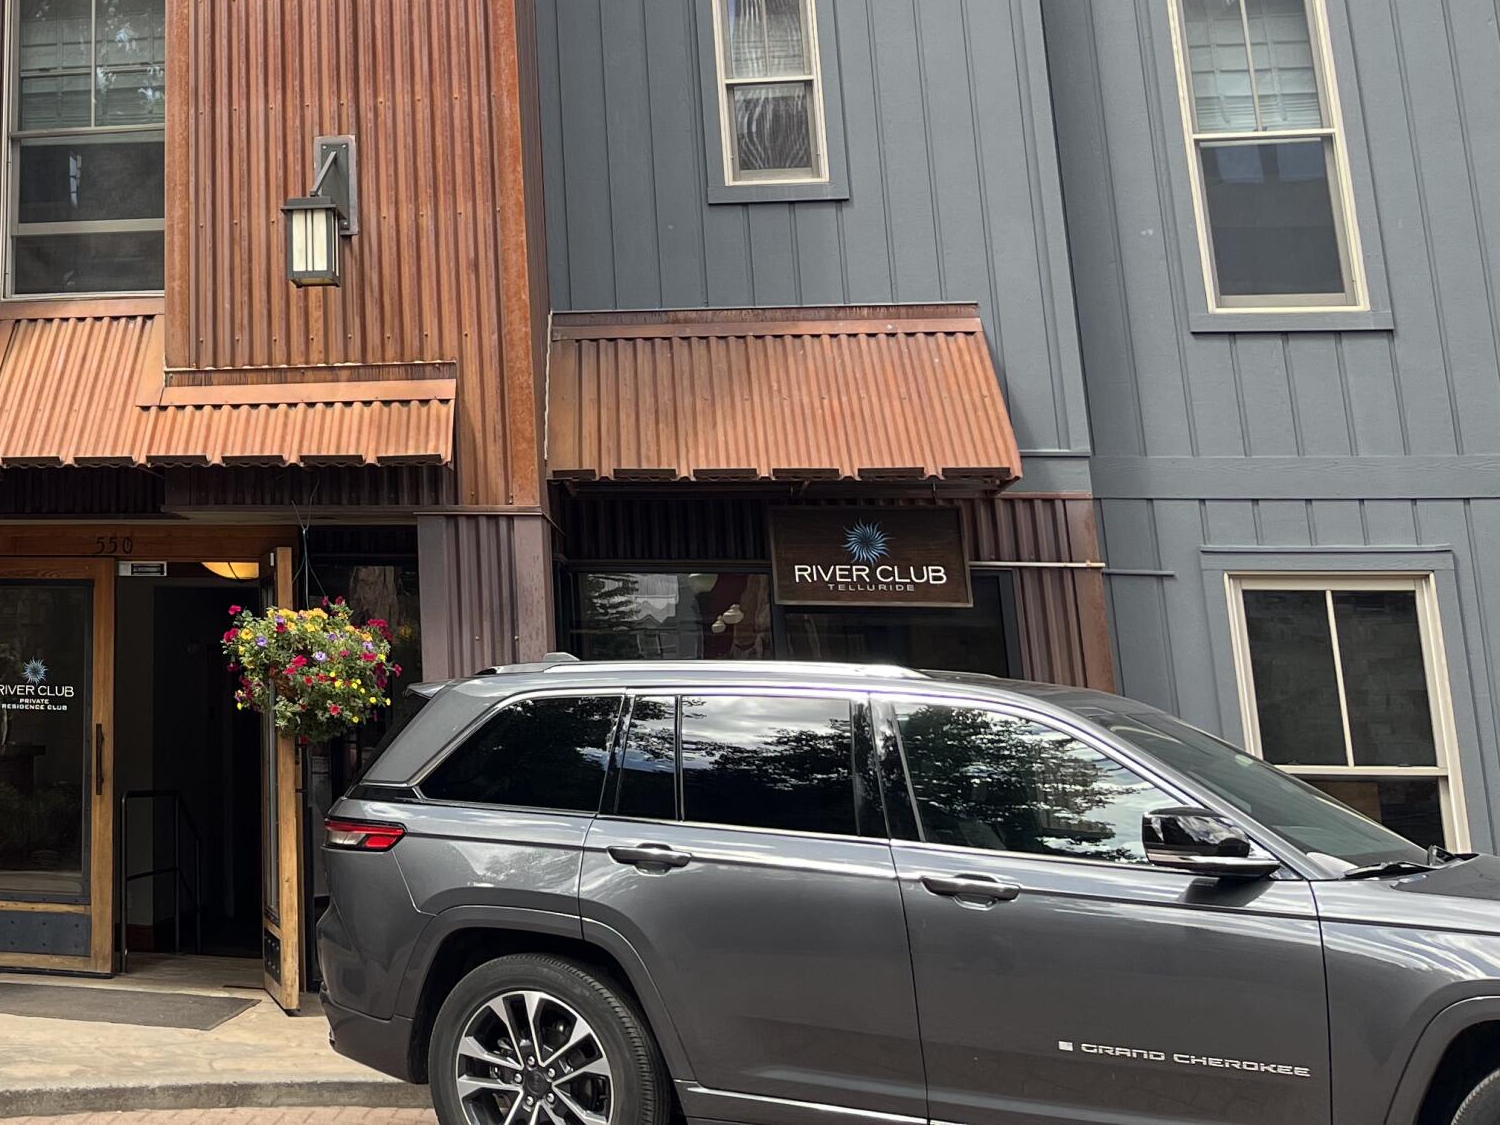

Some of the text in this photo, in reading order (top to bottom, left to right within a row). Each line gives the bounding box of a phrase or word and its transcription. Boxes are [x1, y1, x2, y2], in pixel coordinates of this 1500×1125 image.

[95, 537, 133, 554] 550
[794, 565, 947, 584] RIVER CLUB
[827, 583, 915, 592] TELLURIDE
[37, 685, 75, 697] CLUB
[1081, 1043, 1311, 1077] GRAND CHEROKEE
